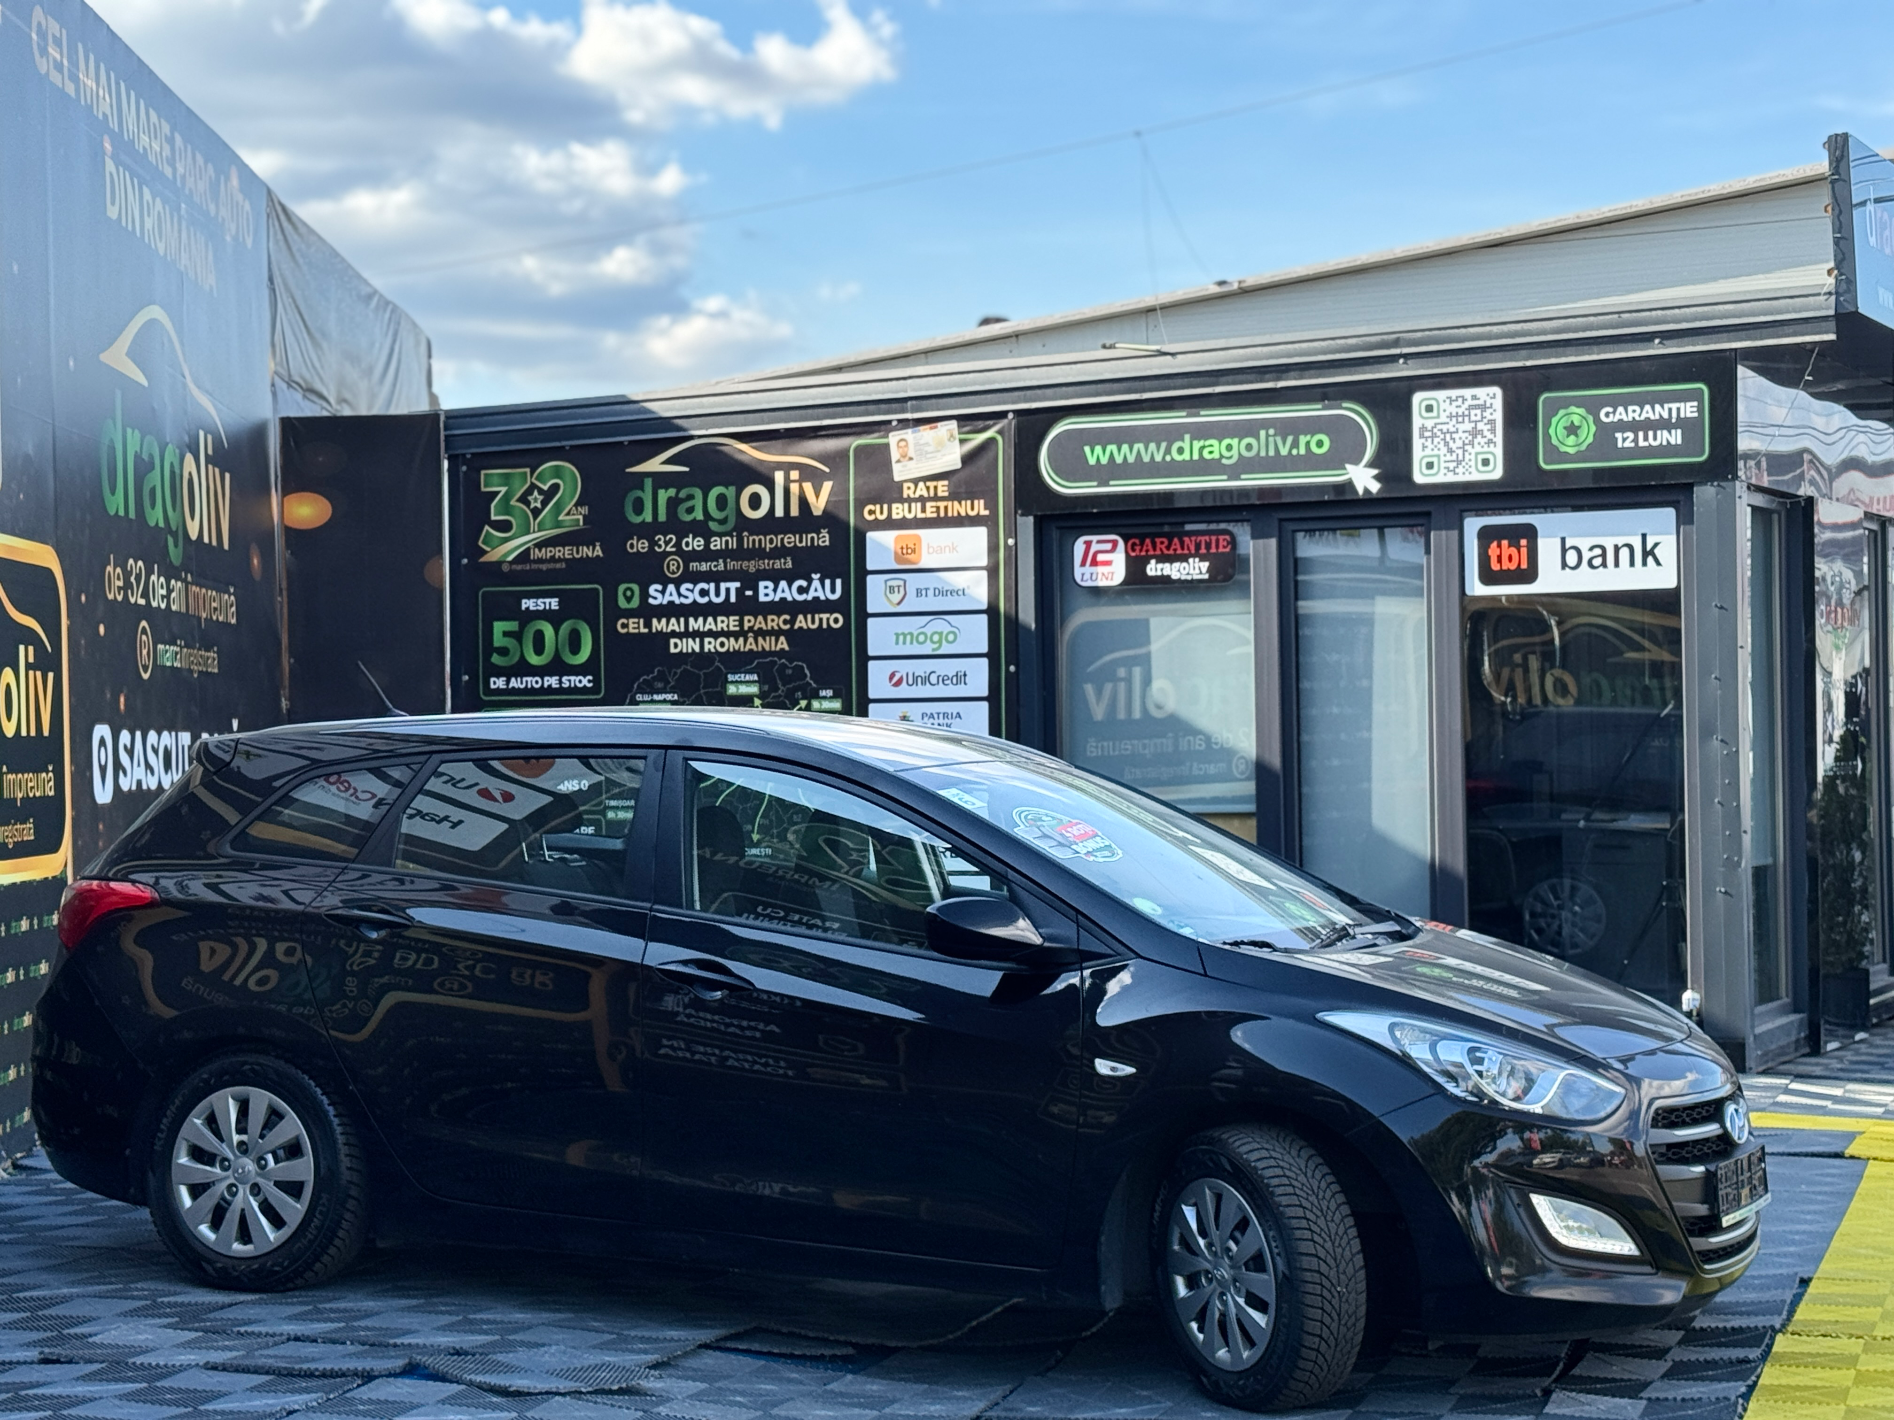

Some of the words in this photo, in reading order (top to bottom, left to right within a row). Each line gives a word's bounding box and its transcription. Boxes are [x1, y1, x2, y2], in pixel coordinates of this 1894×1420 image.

[31, 4, 76, 98] CEL
[77, 42, 119, 133] MAI
[119, 79, 174, 179] MARE
[174, 131, 217, 219] PARC
[217, 175, 253, 250] AUTO
[104, 155, 141, 238] DIN
[1083, 428, 1332, 466] www.dragoliv.ro
[1615, 431, 1636, 448] 12
[1637, 428, 1682, 447] LUNI
[102, 390, 231, 567] dragoliv
[902, 480, 949, 499] RATE
[478, 460, 584, 552] 32
[570, 505, 588, 516] ANI
[624, 470, 834, 532] dragoliv
[863, 503, 889, 520] CU
[891, 500, 990, 519] BULETINUL
[626, 536, 649, 553] de
[654, 535, 677, 551] 32
[681, 533, 705, 550] de
[709, 532, 737, 550] ani
[743, 528, 830, 553] împreună
[899, 542, 917, 556] tbi
[926, 541, 960, 556] bank
[1080, 538, 1119, 568] 12
[1126, 534, 1232, 557] GARANTIE
[1488, 538, 1529, 571] tbi
[1560, 532, 1663, 572] bank
[689, 558, 724, 572] marcă
[726, 556, 793, 573] înregistrată
[1080, 570, 1115, 583] LUNI
[1146, 557, 1210, 580] dragoliv
[105, 553, 124, 602] de
[127, 558, 146, 606] 32
[149, 563, 167, 610] de
[170, 571, 187, 614] ani
[187, 572, 237, 629] împreună
[648, 582, 741, 606] SASCUT
[758, 573, 842, 602] BACĂU
[915, 587, 929, 599] BT
[932, 585, 968, 598] Direct
[521, 598, 559, 611] PESTE
[616, 618, 649, 634] CEL
[652, 616, 685, 633] MAI
[688, 615, 740, 632] MARE
[743, 614, 791, 630] PARC
[794, 612, 844, 629] AUTO
[490, 618, 593, 667] 500
[669, 637, 700, 654] DIN
[703, 633, 789, 653] ROMÂNIA
[893, 630, 959, 653] mogo
[490, 677, 507, 690] DE
[509, 676, 542, 689] AUTO
[544, 676, 560, 689] PE
[562, 675, 593, 688] STOC
[727, 673, 759, 682] SUCEAVA
[906, 669, 968, 688] UniCredit
[635, 693, 678, 701] CLUJ-NAPOCA
[921, 711, 963, 721] PATRIA
[118, 729, 191, 791] SASCUT
[2, 764, 55, 807] împreună
